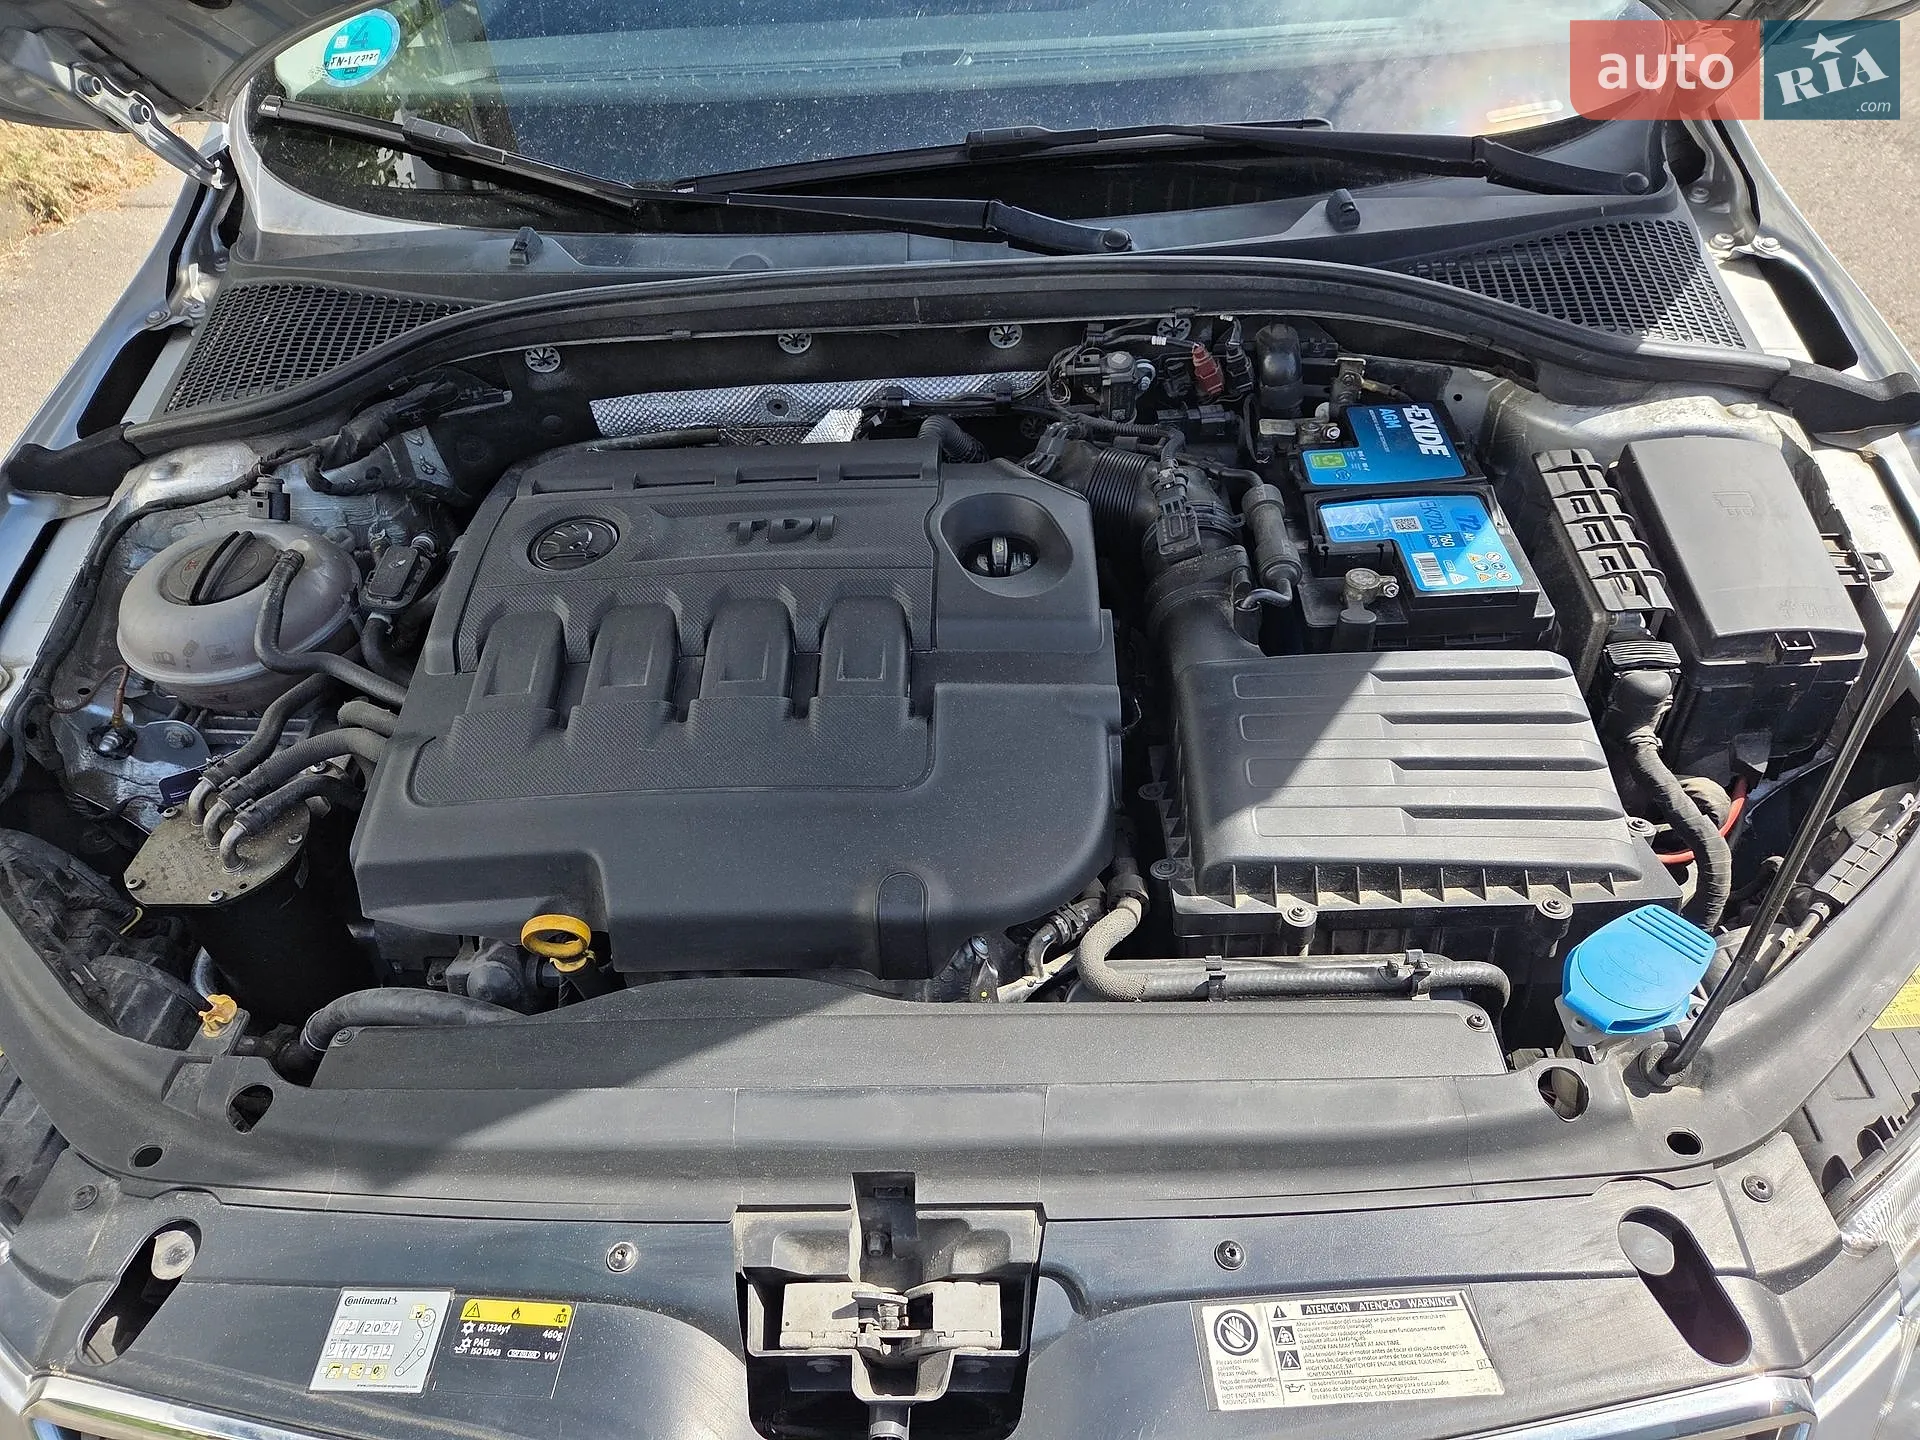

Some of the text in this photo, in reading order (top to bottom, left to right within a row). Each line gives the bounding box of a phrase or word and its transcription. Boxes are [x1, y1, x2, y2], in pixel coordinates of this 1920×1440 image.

[1378, 408, 1402, 429] AGM
[1402, 404, 1450, 457] EXIDE
[1418, 501, 1448, 531] EK720
[1456, 514, 1482, 532] 72
[726, 514, 838, 545] TDI
[1438, 533, 1455, 547] 760
[344, 1296, 392, 1306] Continental
[1306, 1302, 1350, 1314] ATENCIÓN
[1407, 1296, 1452, 1308] WARNING
[478, 1324, 564, 1341] R-1234yf 460g
[473, 1338, 490, 1346] PAG
[544, 1352, 558, 1360] VW
